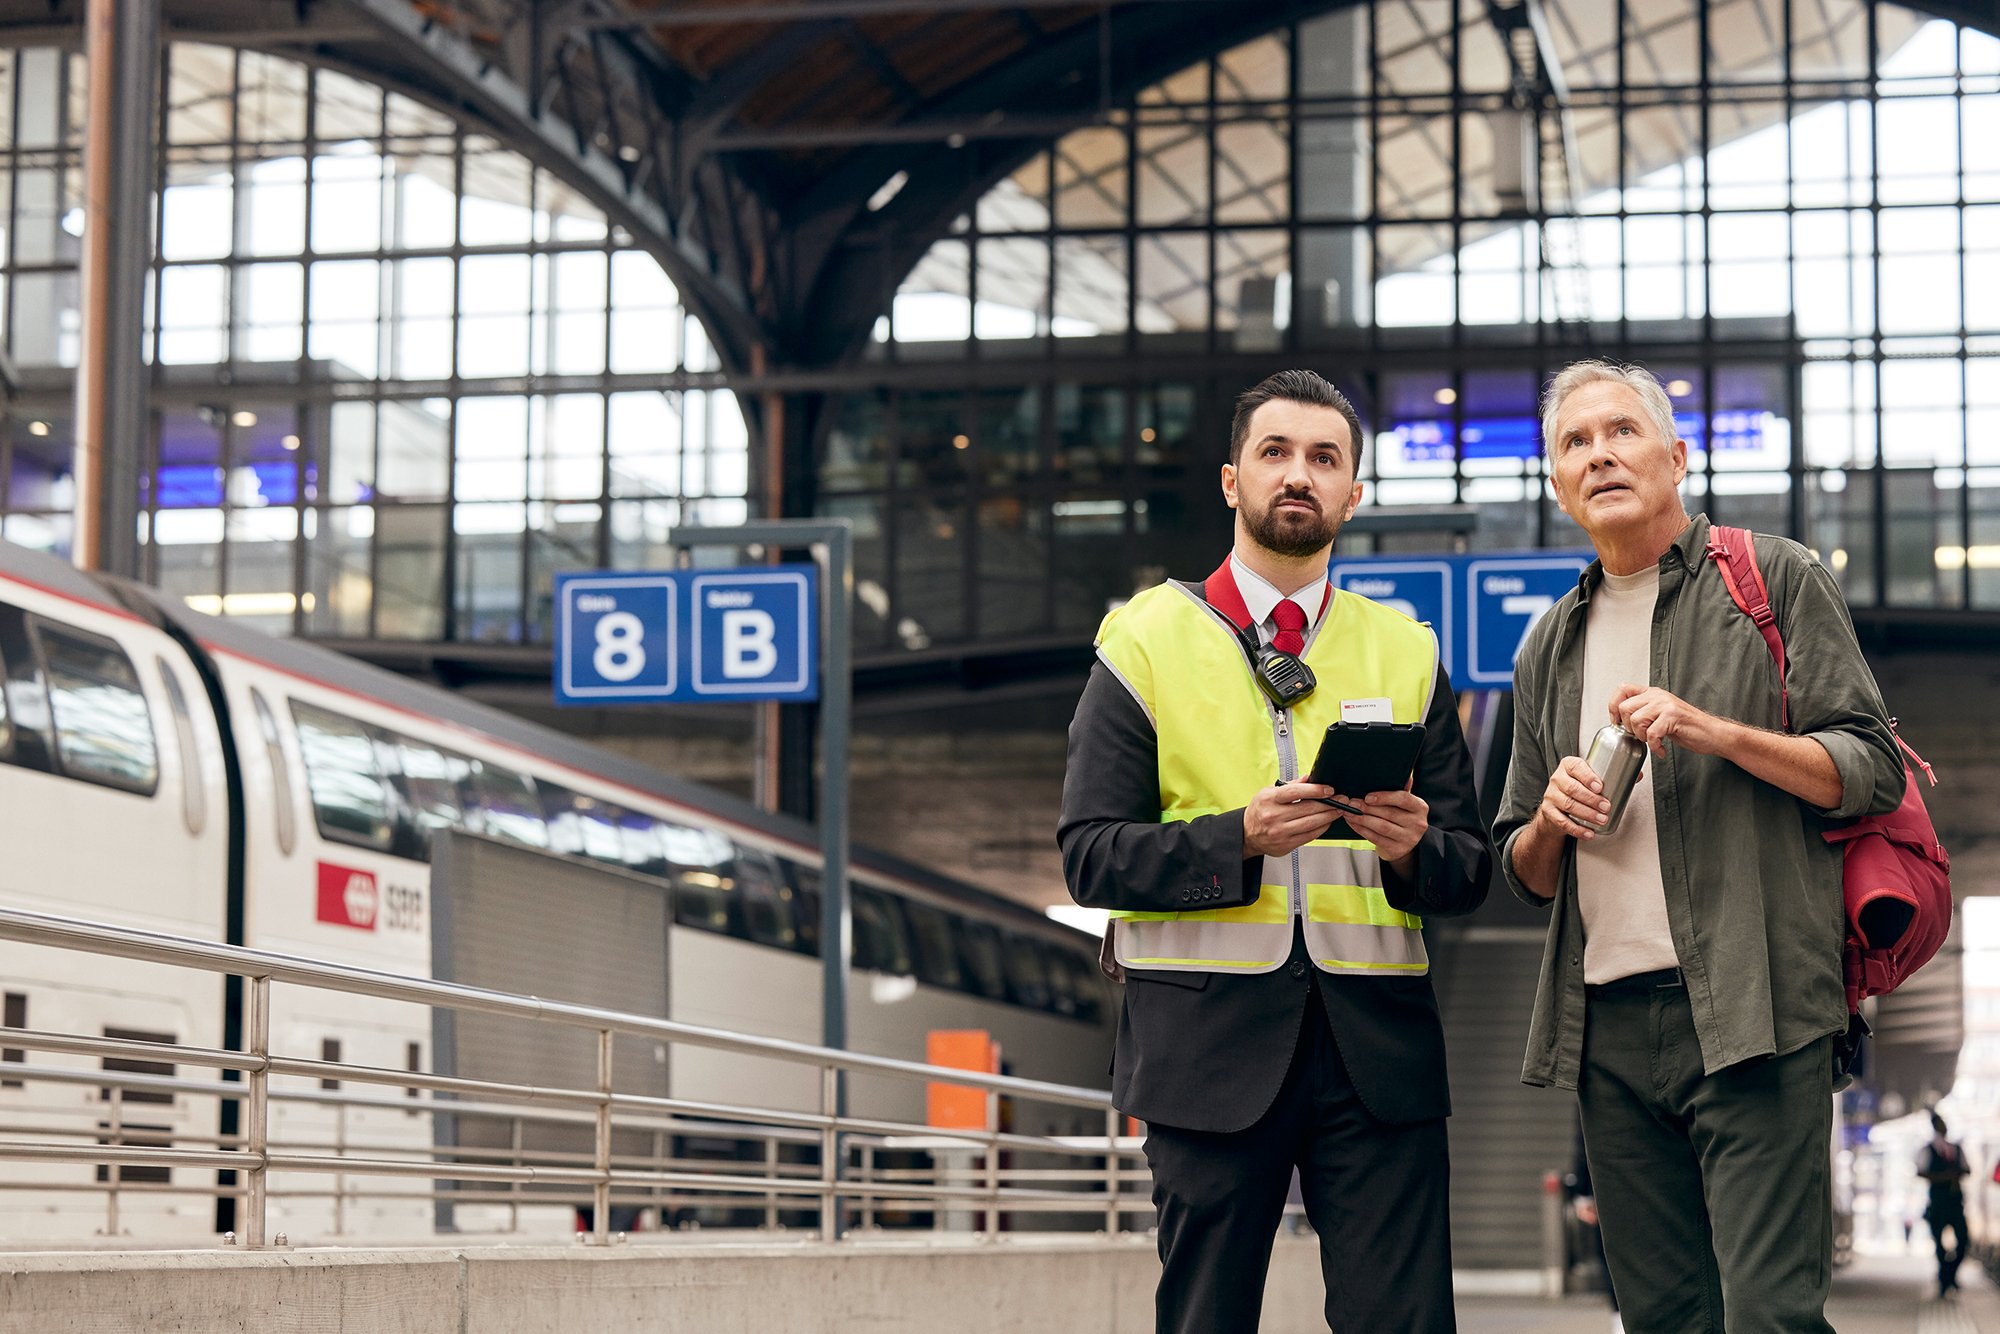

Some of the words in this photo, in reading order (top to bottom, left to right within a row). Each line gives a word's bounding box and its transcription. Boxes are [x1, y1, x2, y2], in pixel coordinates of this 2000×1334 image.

[593, 611, 646, 681] 8
[722, 609, 778, 678] B
[1502, 595, 1555, 666] 7
